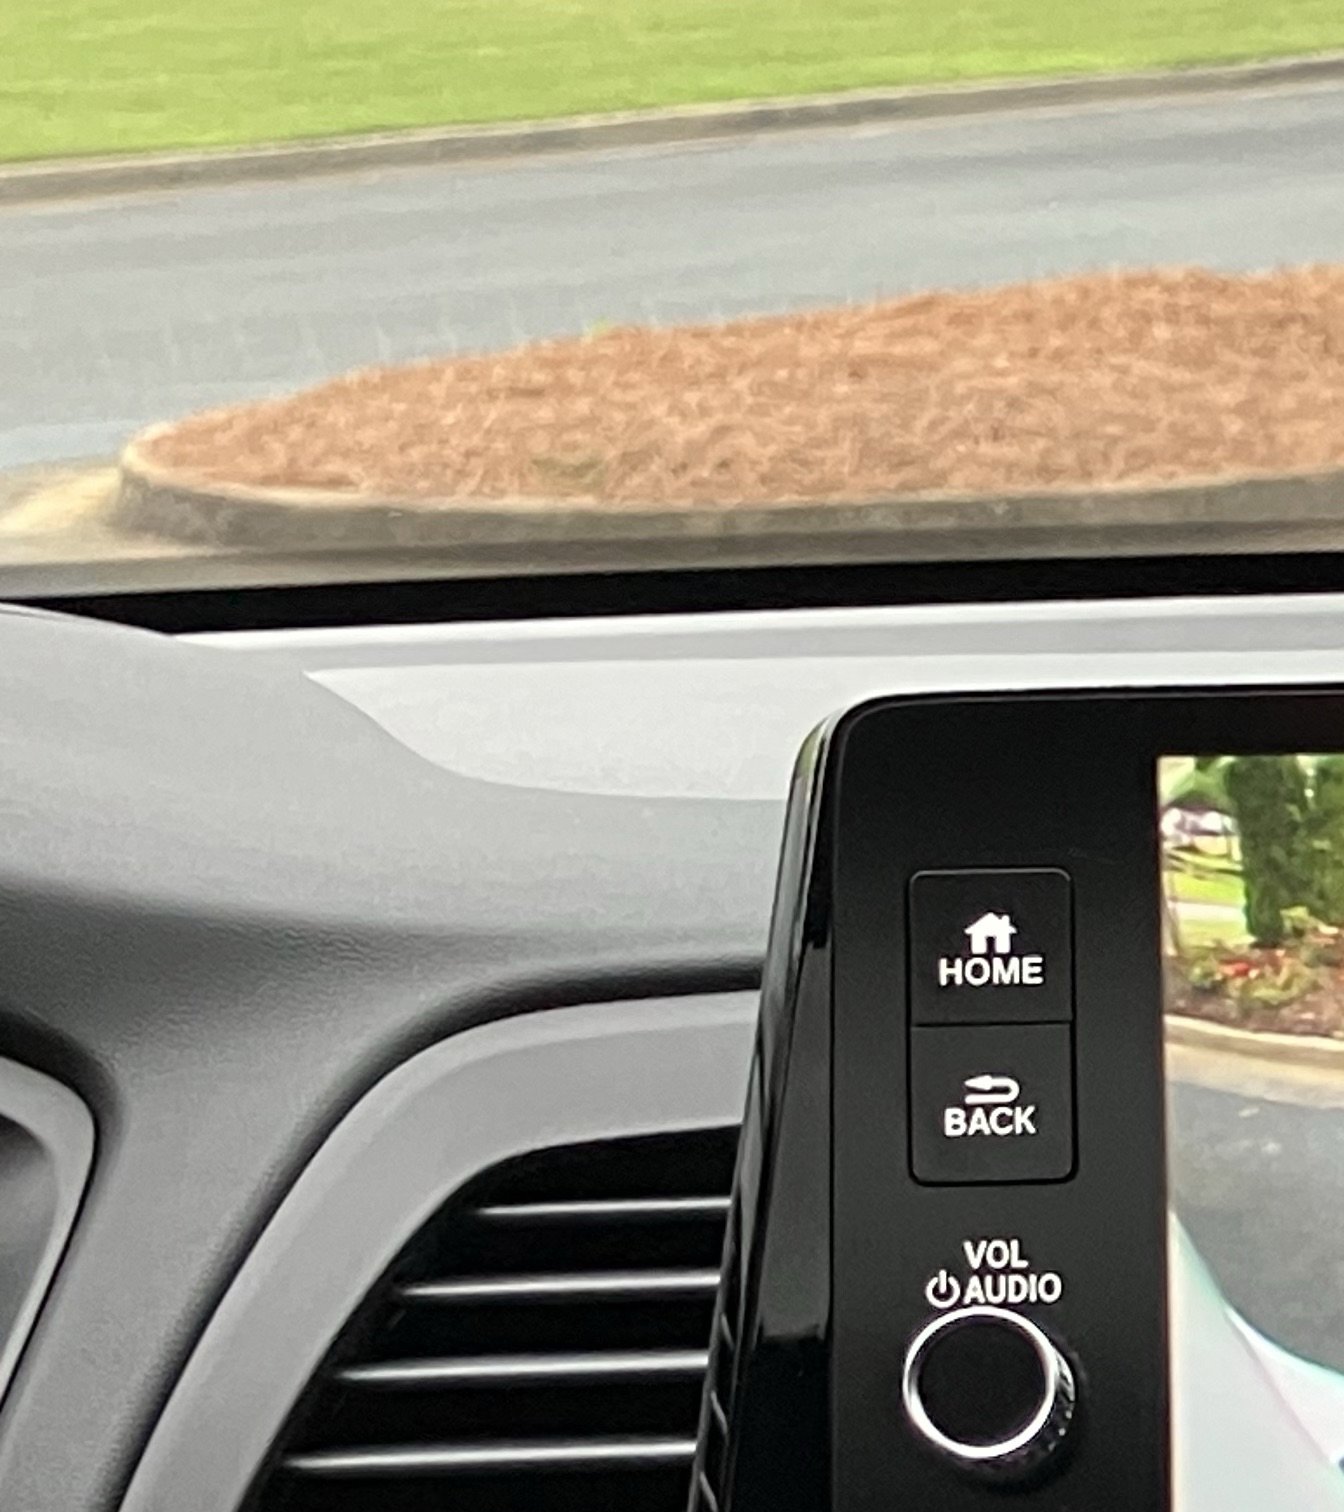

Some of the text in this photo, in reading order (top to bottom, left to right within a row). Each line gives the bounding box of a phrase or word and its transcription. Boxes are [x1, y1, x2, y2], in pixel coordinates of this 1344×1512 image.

[938, 956, 1044, 986] HOME
[944, 1105, 1036, 1137] BACK
[963, 1239, 1029, 1270] VOL
[963, 1272, 1062, 1303] AUDIO
